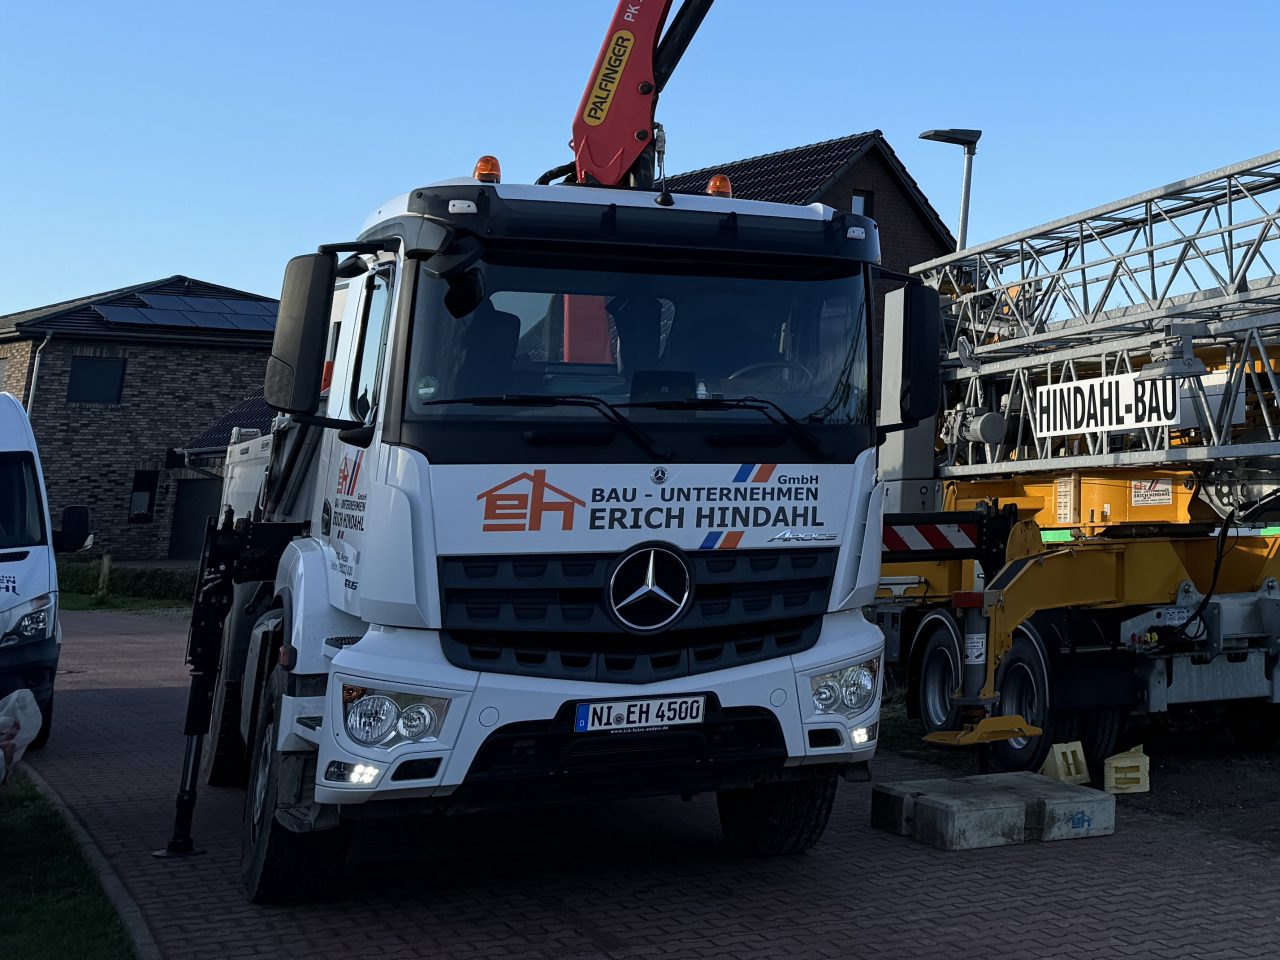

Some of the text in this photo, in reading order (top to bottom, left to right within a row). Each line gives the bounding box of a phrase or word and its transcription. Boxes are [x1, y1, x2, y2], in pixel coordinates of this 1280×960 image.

[624, 3, 640, 22] PK
[586, 35, 631, 121] PALFINGER
[1038, 377, 1177, 434] HINDAHL-BAU
[777, 474, 819, 485] GmbH
[591, 487, 637, 503] BAU
[660, 486, 819, 502] UNTERNEHMEN
[589, 505, 825, 530] ERICH HINDAHL
[591, 699, 700, 727] NI EH 4500
